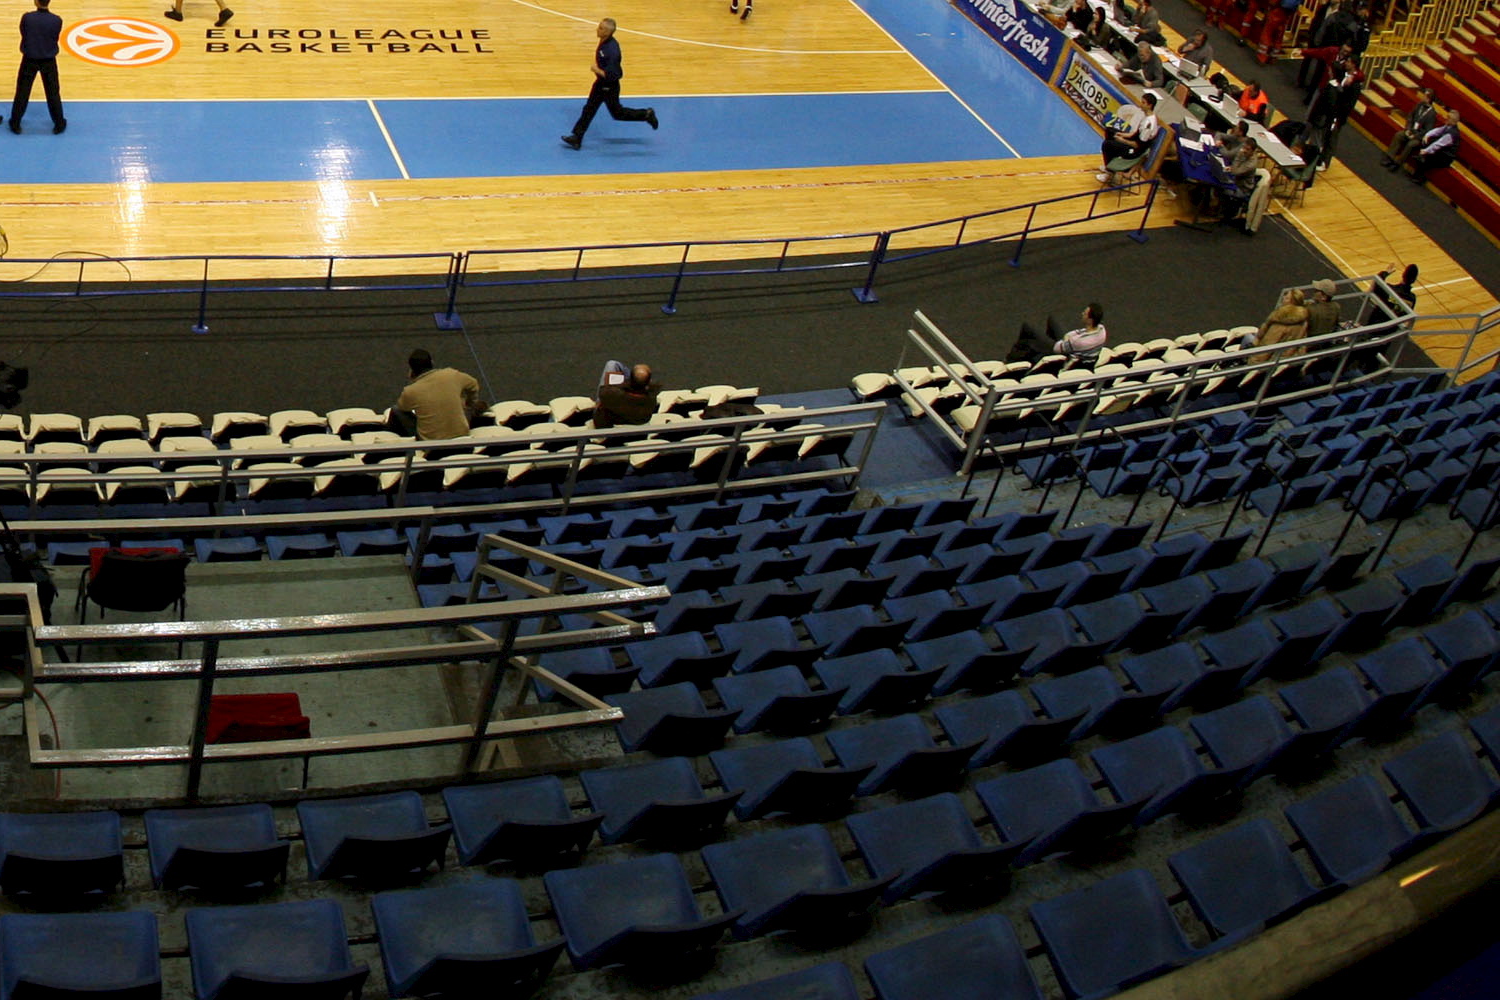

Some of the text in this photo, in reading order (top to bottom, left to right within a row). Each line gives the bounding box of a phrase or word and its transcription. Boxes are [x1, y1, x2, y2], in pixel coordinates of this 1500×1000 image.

[205, 28, 492, 41] EUROLEAGUE
[205, 42, 495, 54] BASKETBALL
[1068, 70, 1109, 110] JACOBS
